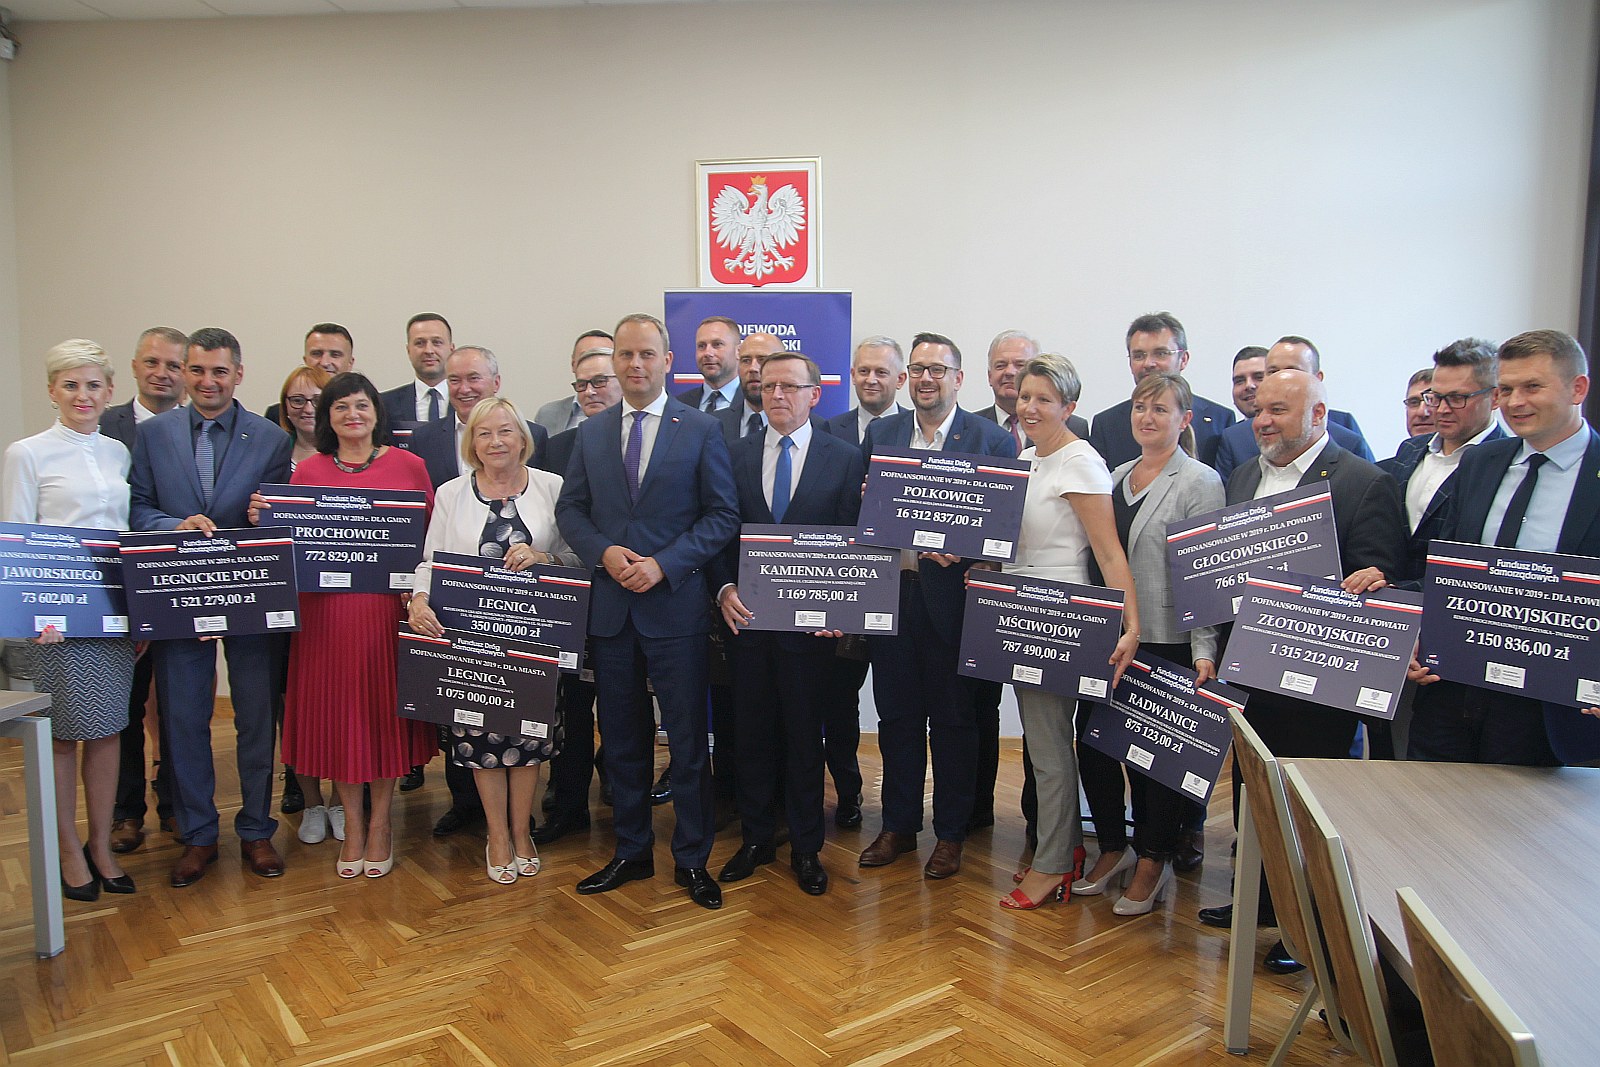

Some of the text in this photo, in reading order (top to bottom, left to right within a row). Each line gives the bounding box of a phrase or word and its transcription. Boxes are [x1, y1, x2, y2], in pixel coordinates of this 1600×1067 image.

[737, 324, 797, 336] JEWODA
[922, 463, 975, 474] Samorządowych
[928, 457, 971, 468] Fundusz Dróg
[881, 471, 944, 483] DOFINANSOWANIE
[989, 482, 1014, 491] GMINY
[350, 496, 366, 504] Dróg
[903, 486, 984, 504] POLKOWICE
[316, 501, 372, 510] Samorządowych
[273, 513, 341, 521] DOFINANSOWANIE
[896, 508, 983, 527] 16 312 837,00 zł
[1218, 511, 1272, 531] Samorządowych
[1222, 507, 1266, 522] Fundusz Dróg
[295, 527, 389, 540] PROCHOWICE
[826, 534, 842, 542] Dróg
[1177, 534, 1240, 556] DOFINANSOWANIE
[1241, 531, 1249, 540] W
[1270, 522, 1285, 532] DLA
[1286, 513, 1323, 528] POWIATU
[178, 544, 237, 554] Samorządowych
[793, 539, 847, 548] Samorządowych
[1192, 532, 1309, 569] GŁOGOWSKIEGO
[305, 551, 378, 563] 772 829,00 zł
[748, 551, 805, 559] DOFINANSOWANIE
[137, 559, 206, 568] DOFINANSOWANIE
[760, 565, 879, 578] KAMIENNA GÓRA
[1497, 559, 1553, 574] Fundusz Dróg
[3, 567, 103, 581] JAWORSKIEGO
[152, 569, 269, 586] LEGNICKIE POLE
[484, 572, 537, 584] Samorządowych
[1215, 574, 1235, 589] 766
[1489, 567, 1559, 583] Samorządowych
[442, 580, 506, 593] DOFINANSOWANIE
[549, 592, 577, 601] MIASTA
[777, 589, 858, 602] 1 169 785,00 zł
[1016, 590, 1069, 605] Samorządowych
[1022, 585, 1064, 598] Fundusz Dróg
[1310, 585, 1340, 597] Fundusz
[1435, 577, 1514, 594] DOFINANSOWANIE
[1515, 588, 1524, 596] W
[1525, 589, 1543, 598] 2019
[1552, 593, 1572, 602] DLA
[22, 592, 88, 605] 73 602,00 zł
[170, 593, 256, 608] 1 521 279,00 zł
[478, 598, 537, 614] LEGNICA
[1302, 590, 1363, 608] Samorządowych
[978, 598, 1039, 613] DOFINANSOWANIE
[1039, 607, 1047, 615] W
[1067, 612, 1081, 620] DLA
[1082, 614, 1108, 624] GMINY
[1251, 597, 1410, 631] DOFINANSOWANIE W 2019 DLA POWIATU
[1446, 596, 1600, 631] ZŁOTORYJSKIEGO
[471, 620, 491, 632] 350
[492, 622, 527, 637] 000,00
[529, 626, 541, 637] zł
[998, 616, 1082, 638] MŚCIWOJÓW
[1257, 614, 1390, 648] ZŁOTORYJSKIEGO
[452, 643, 506, 657] Samorządowych
[457, 638, 501, 651] Fundusz Dróg
[1002, 641, 1071, 662] 787 490,00 zł
[1465, 630, 1570, 660] 2 150 836,00 zł
[410, 648, 475, 665] DOFINANSOWANIE
[503, 663, 517, 671] DLA
[519, 666, 547, 676] MIASTA
[1269, 643, 1359, 671] 1 315 212,00 zł
[448, 667, 507, 686] LEGNICA
[1150, 671, 1195, 694] Samorządowych
[1156, 667, 1193, 686] Fundusz Dróg
[436, 687, 515, 708] 1 075 000,00 zł
[1121, 673, 1166, 698] OFINANSOWANIE
[1166, 693, 1173, 701] W
[1190, 703, 1203, 714] DLA
[1203, 708, 1226, 724] GMINY
[1129, 693, 1199, 732] RADWANICE
[1125, 719, 1184, 754] 875 123,00 zł
